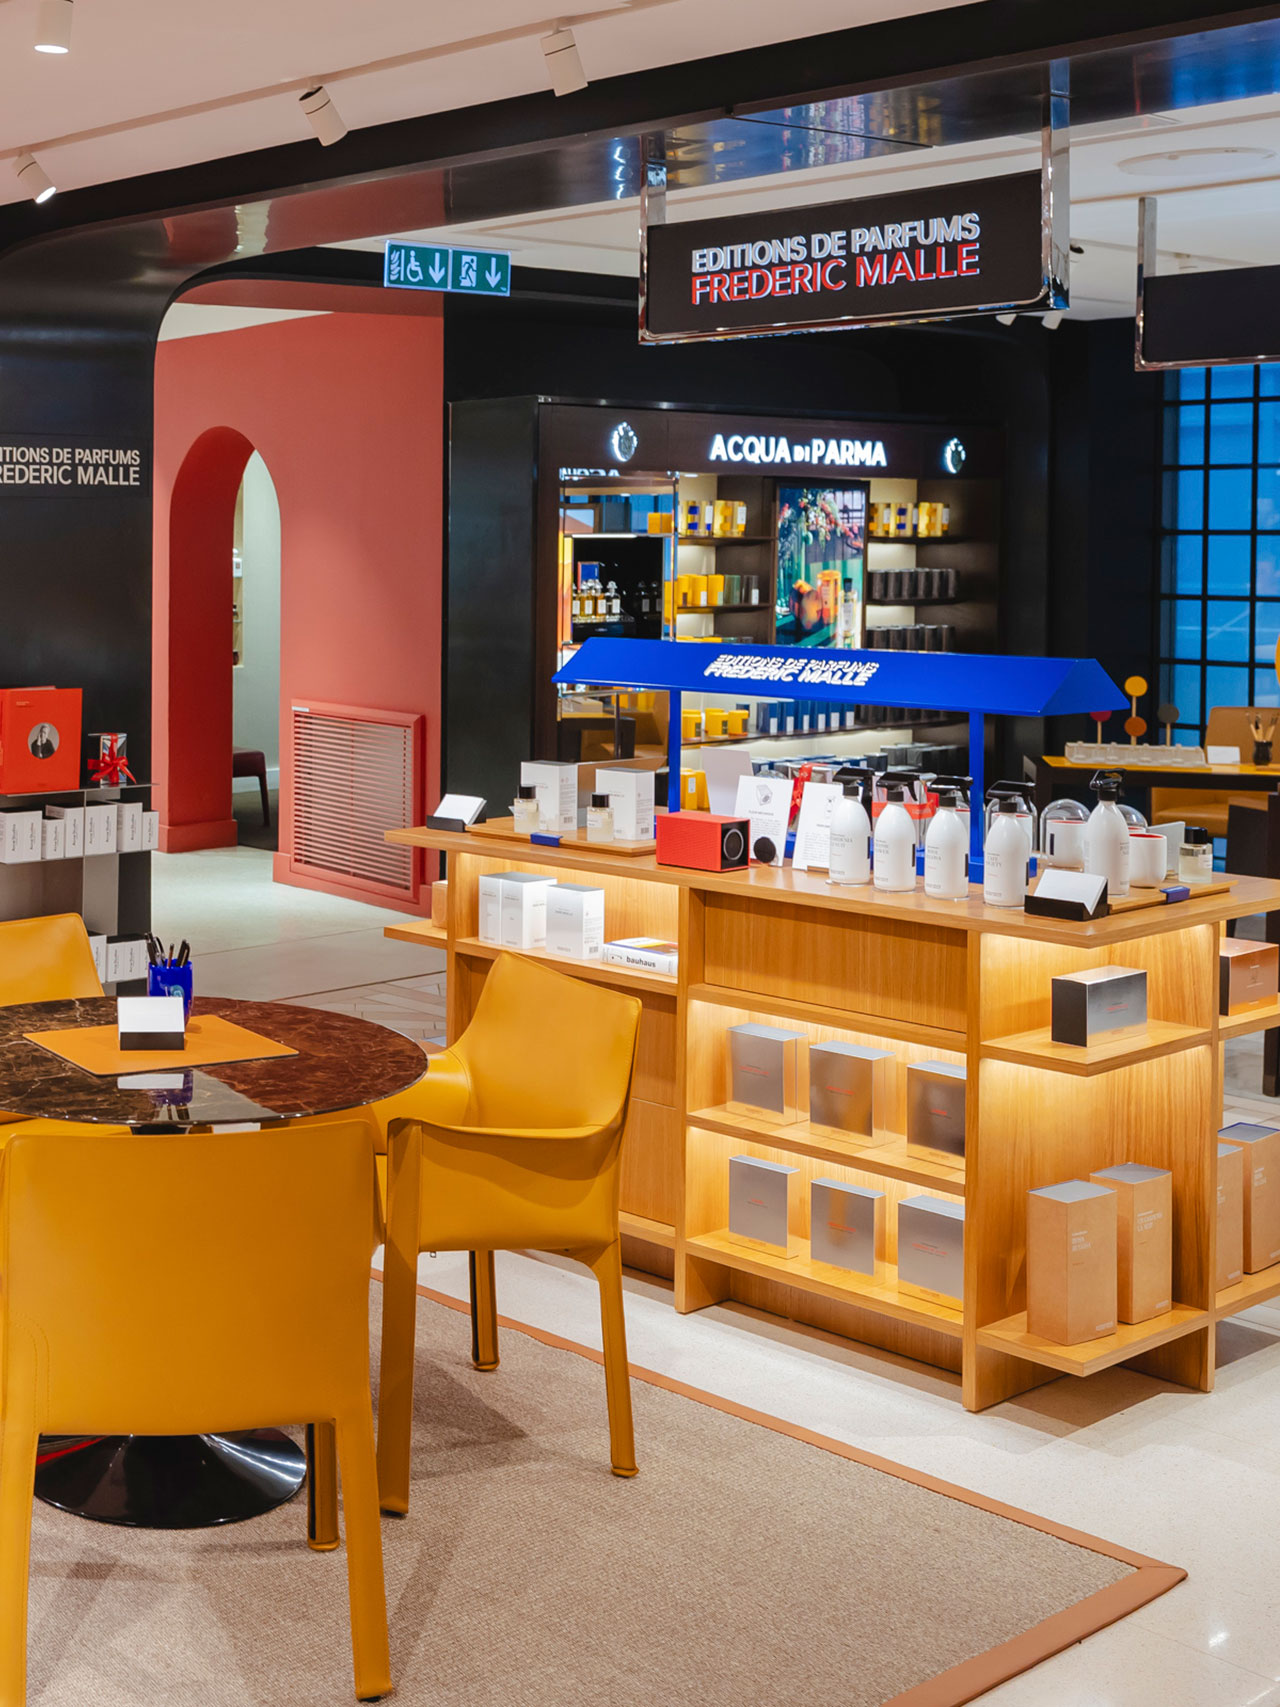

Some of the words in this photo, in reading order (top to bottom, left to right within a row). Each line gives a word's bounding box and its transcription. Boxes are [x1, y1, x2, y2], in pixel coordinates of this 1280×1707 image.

[691, 235, 807, 273] EDITIONS
[811, 230, 847, 259] DE
[851, 212, 980, 254] PARFUMS
[691, 258, 847, 305] FREDERIC
[855, 242, 980, 288] MALLE
[52, 448, 72, 464] DE
[75, 449, 140, 465] PARFUMS
[709, 434, 792, 464] ACQUA
[811, 438, 887, 467] PARMA
[77, 466, 140, 486] MALLE
[716, 654, 785, 669] EDITIONS
[785, 658, 807, 670] DE
[808, 659, 879, 673] PARFUMS
[704, 663, 798, 682] FREDERIC
[798, 669, 873, 686] MALLE
[626, 956, 656, 968] bauhaus
